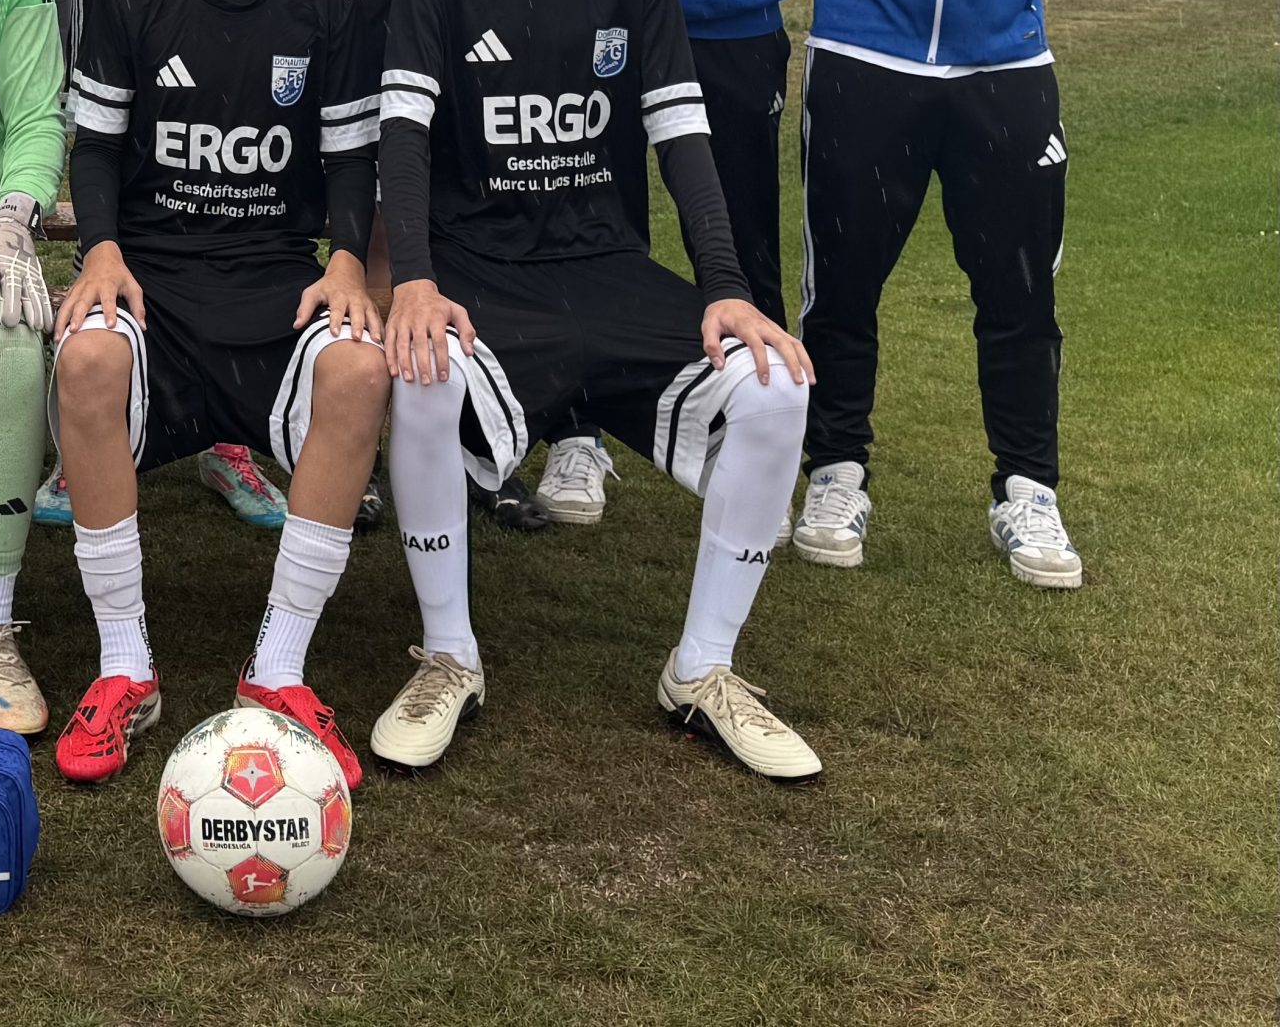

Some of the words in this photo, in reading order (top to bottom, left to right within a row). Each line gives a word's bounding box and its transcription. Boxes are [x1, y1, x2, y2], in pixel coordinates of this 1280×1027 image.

[482, 90, 611, 145] ERGO
[155, 120, 293, 175] ERGO
[173, 179, 277, 199] Geschäftsstelle
[489, 177, 526, 191] Marc
[528, 180, 541, 191] u.
[155, 192, 186, 211] Marc
[203, 202, 245, 218] Lukas
[247, 200, 286, 217] Horsch
[201, 817, 310, 842] DERBYSTAR
[209, 842, 252, 850] BUNDESLIGA
